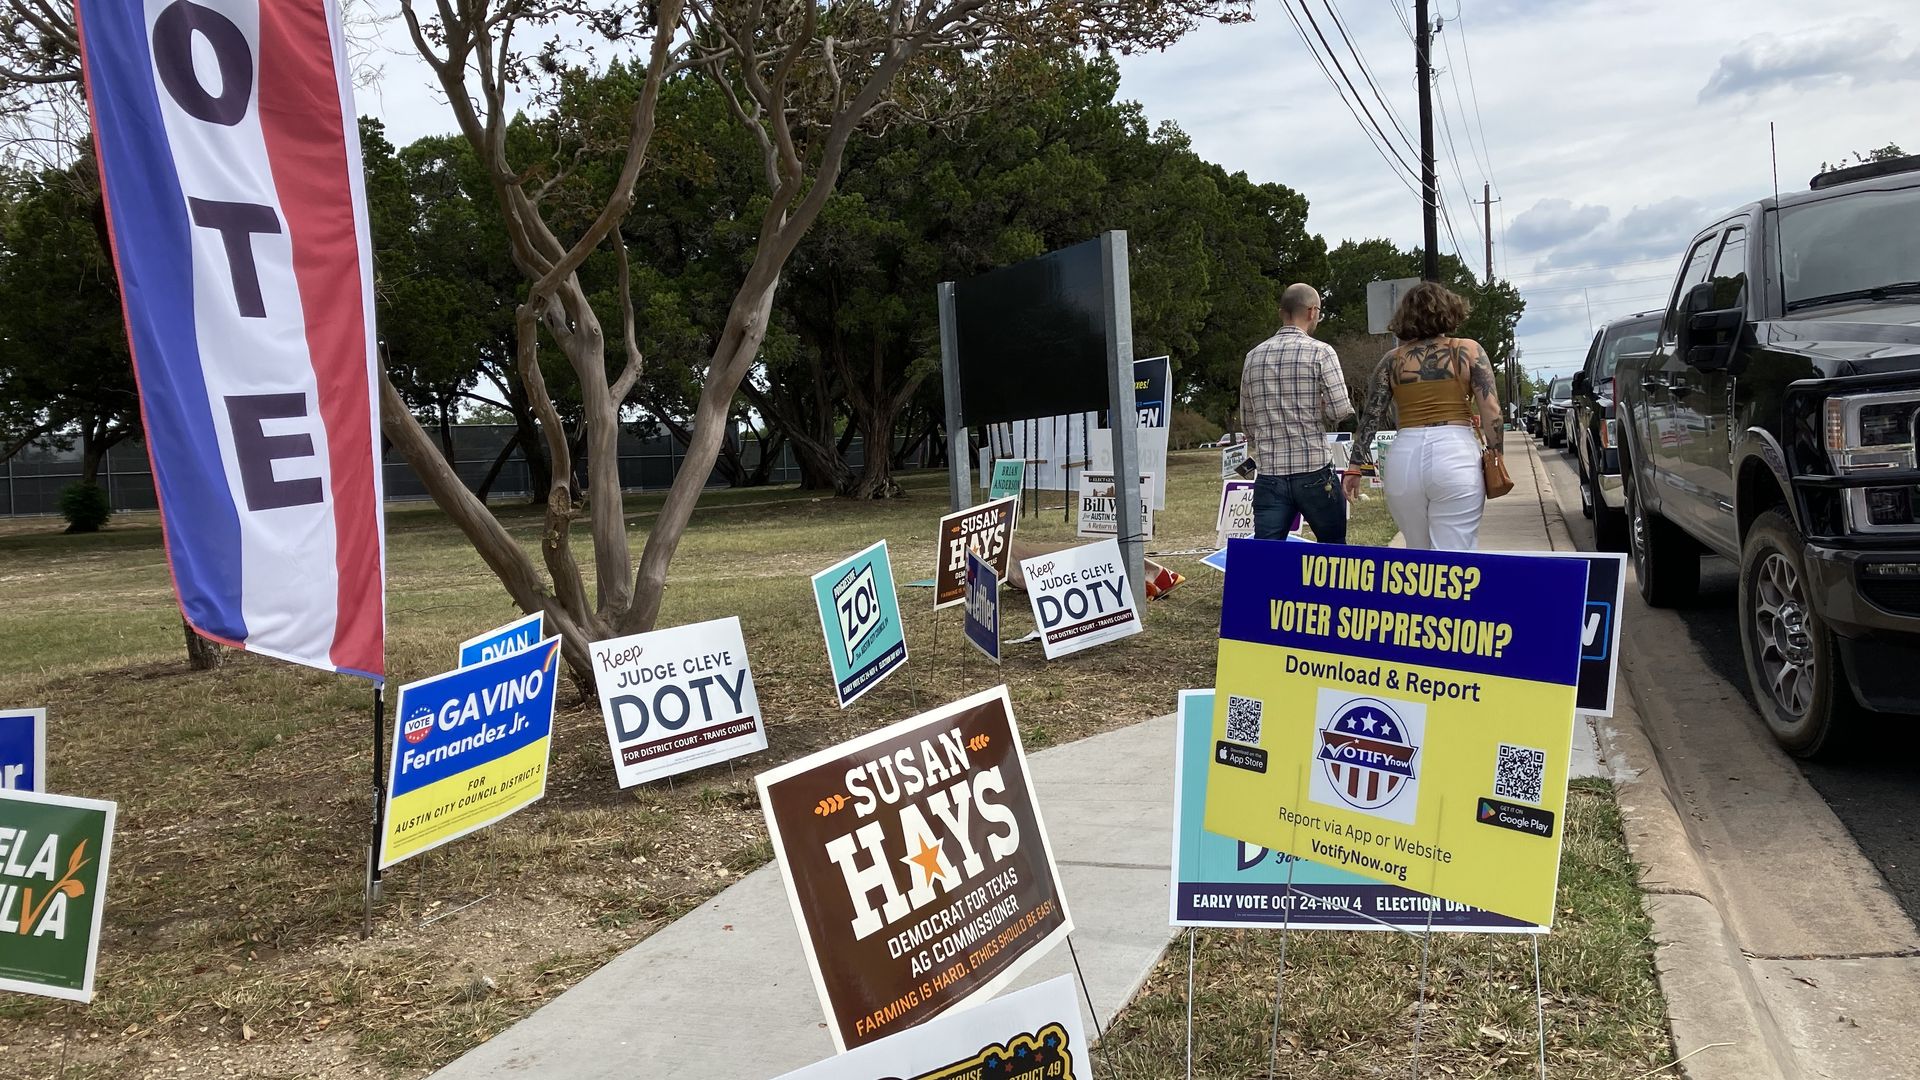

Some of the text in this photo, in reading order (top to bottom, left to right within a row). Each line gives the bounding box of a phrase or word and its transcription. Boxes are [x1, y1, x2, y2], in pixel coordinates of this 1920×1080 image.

[1134, 379, 1150, 390] xes!
[1136, 408, 1160, 428] EN
[994, 480, 1020, 490] ANDERSON
[1002, 466, 1018, 476] BRIAN
[961, 508, 999, 535] SUSAN
[1082, 498, 1105, 512] Bill
[1233, 518, 1251, 528] FOR
[948, 523, 1006, 571] HAYS
[1025, 560, 1056, 580] Keep
[1040, 562, 1114, 592] JUDGE CLEVE
[1302, 554, 1481, 600] VOTING ISSUES?
[842, 578, 877, 642] ZO!
[1036, 575, 1124, 628] DOTY
[1059, 628, 1079, 638] DISTRICT
[1080, 622, 1095, 632] COURT
[1098, 616, 1114, 626] TRAVIS
[1114, 612, 1133, 622] COUNTY
[1270, 599, 1513, 658] VOTER SUPPRESSION?
[596, 644, 643, 673] Keep
[617, 651, 732, 688] JUDGE CLEVE
[1285, 654, 1481, 702] Download & Report
[438, 670, 543, 731] GAVINO
[610, 669, 746, 743] DOTY
[401, 713, 529, 774] Fernandez Jr.
[408, 716, 430, 735] VOTE
[624, 751, 640, 762] FOR
[641, 742, 673, 758] DISTRICT
[674, 736, 698, 749] COURT
[702, 728, 727, 742] TRAVIS
[727, 720, 755, 735] COUNTY
[844, 727, 972, 818] SUSAN
[1229, 753, 1264, 769] App Store
[394, 764, 541, 834] AUSTIN CITY COUNCIL DISTRICT 3
[468, 776, 486, 790] FOR
[1278, 806, 1452, 864] Report via App or Website
[1499, 812, 1548, 833] Google Play
[824, 766, 1020, 941] HAYS
[1312, 839, 1408, 881] VotifyNow.org
[888, 866, 1018, 960] DEMOCRAT FOR TEXAS
[1193, 894, 1232, 910] EARLY
[1235, 894, 1268, 910] VOTE
[1271, 895, 1298, 910] OCT
[1300, 896, 1350, 911] 24-NOV
[1353, 896, 1362, 910] 4
[1376, 896, 1441, 912] ELECTION
[910, 951, 932, 983] AG
[932, 894, 1020, 964] COMMISSIONER
[855, 898, 1056, 1038] FARMING IS HARD. ETHICS SHOULD BE EASY.
[949, 1068, 982, 1080] USE
[1047, 1060, 1060, 1077] 49
